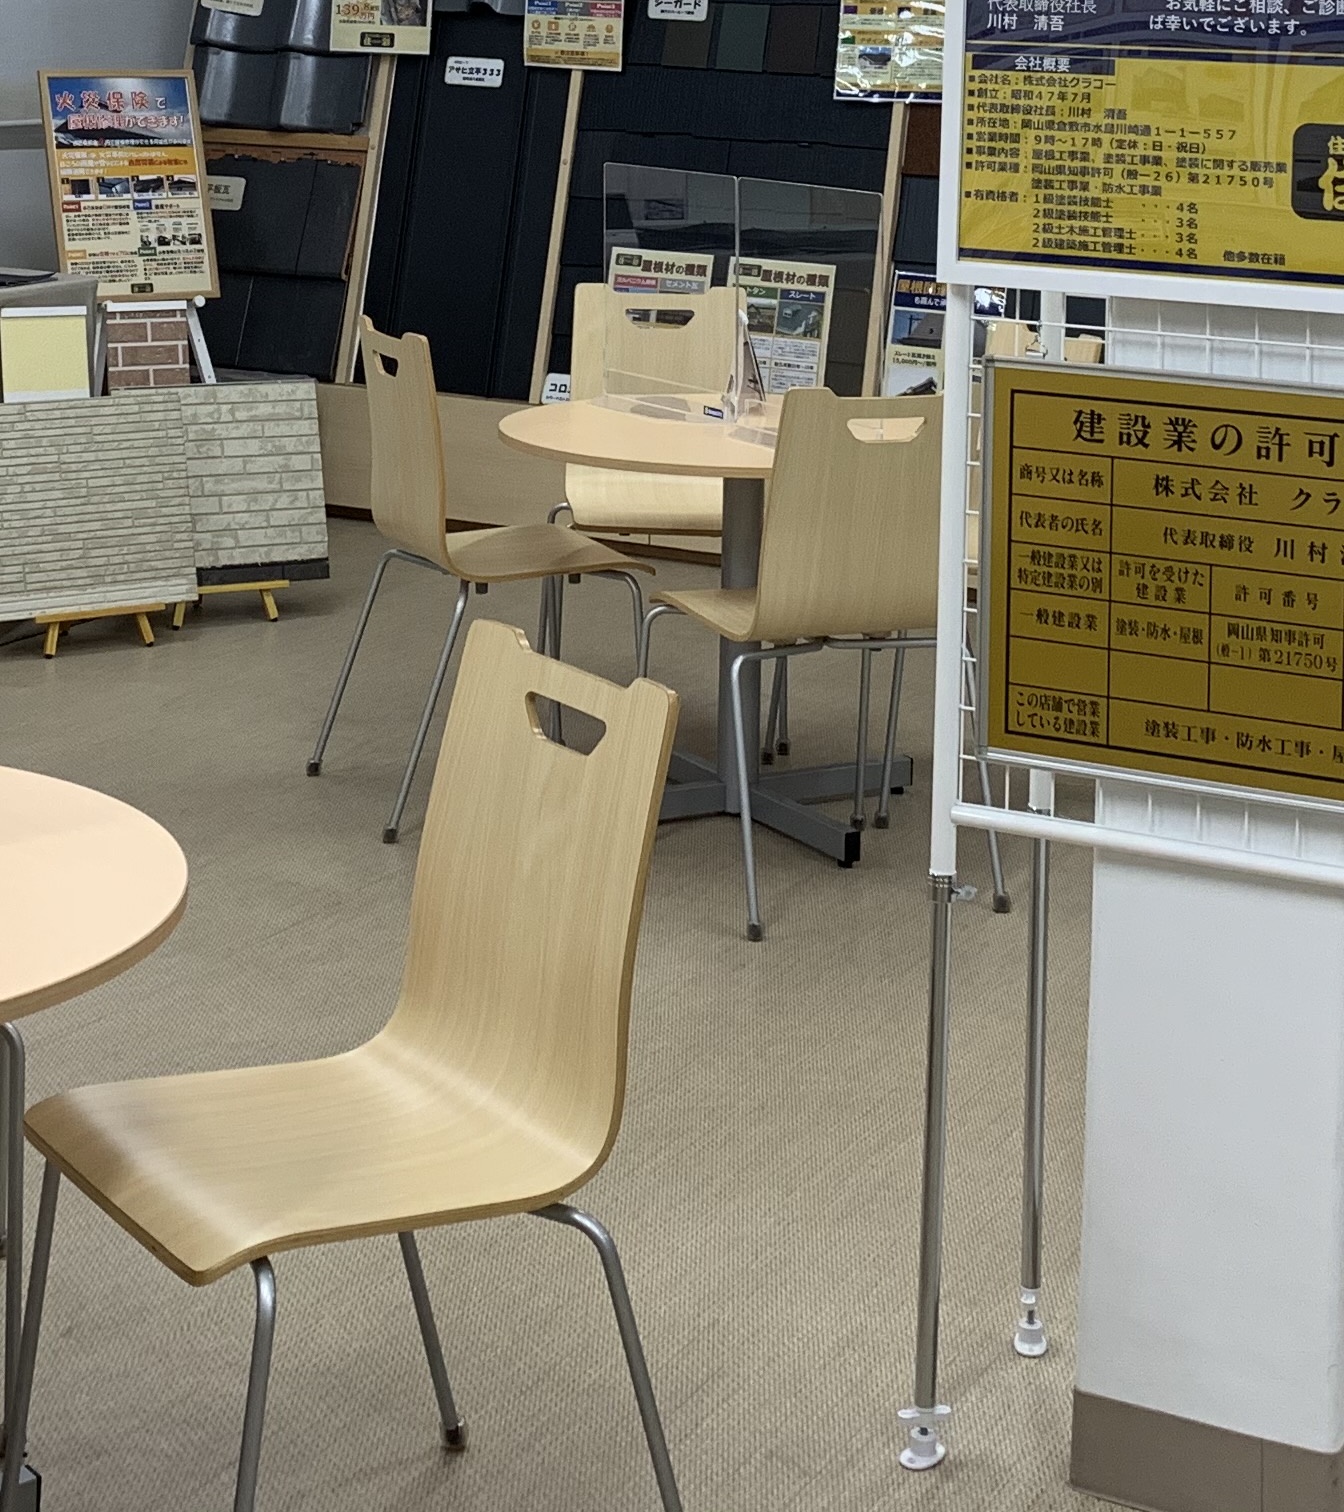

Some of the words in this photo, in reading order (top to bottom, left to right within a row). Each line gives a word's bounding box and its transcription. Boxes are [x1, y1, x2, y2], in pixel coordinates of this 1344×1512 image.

[987, 14, 1018, 30] 川村
[1034, 14, 1064, 32] 清吾
[1149, 14, 1308, 36] ば幸いでございます。
[1014, 55, 1071, 73] 会社概要
[549, 382, 571, 394] コロ
[1019, 463, 1105, 489] 商号又は名称
[1152, 473, 1259, 507] 株式会社
[1019, 510, 1104, 537] 代表者の氏名
[1163, 526, 1255, 554] 代表取締役
[1017, 549, 1103, 574] 一般建設業又は
[1119, 559, 1204, 588] 許可を受けた
[1017, 567, 1103, 595] 特定建設業の別
[1136, 582, 1187, 605] 建設業
[1234, 584, 1319, 612] 許可番号
[1019, 607, 1098, 632] 一般建設業
[1115, 617, 1204, 646] 塗装・防水・屋根
[1227, 621, 1325, 650] 岡山県知事許可
[1258, 646, 1338, 673] 第21750号
[1015, 691, 1101, 719] この店舗で営業
[1015, 710, 1101, 738] している建設業
